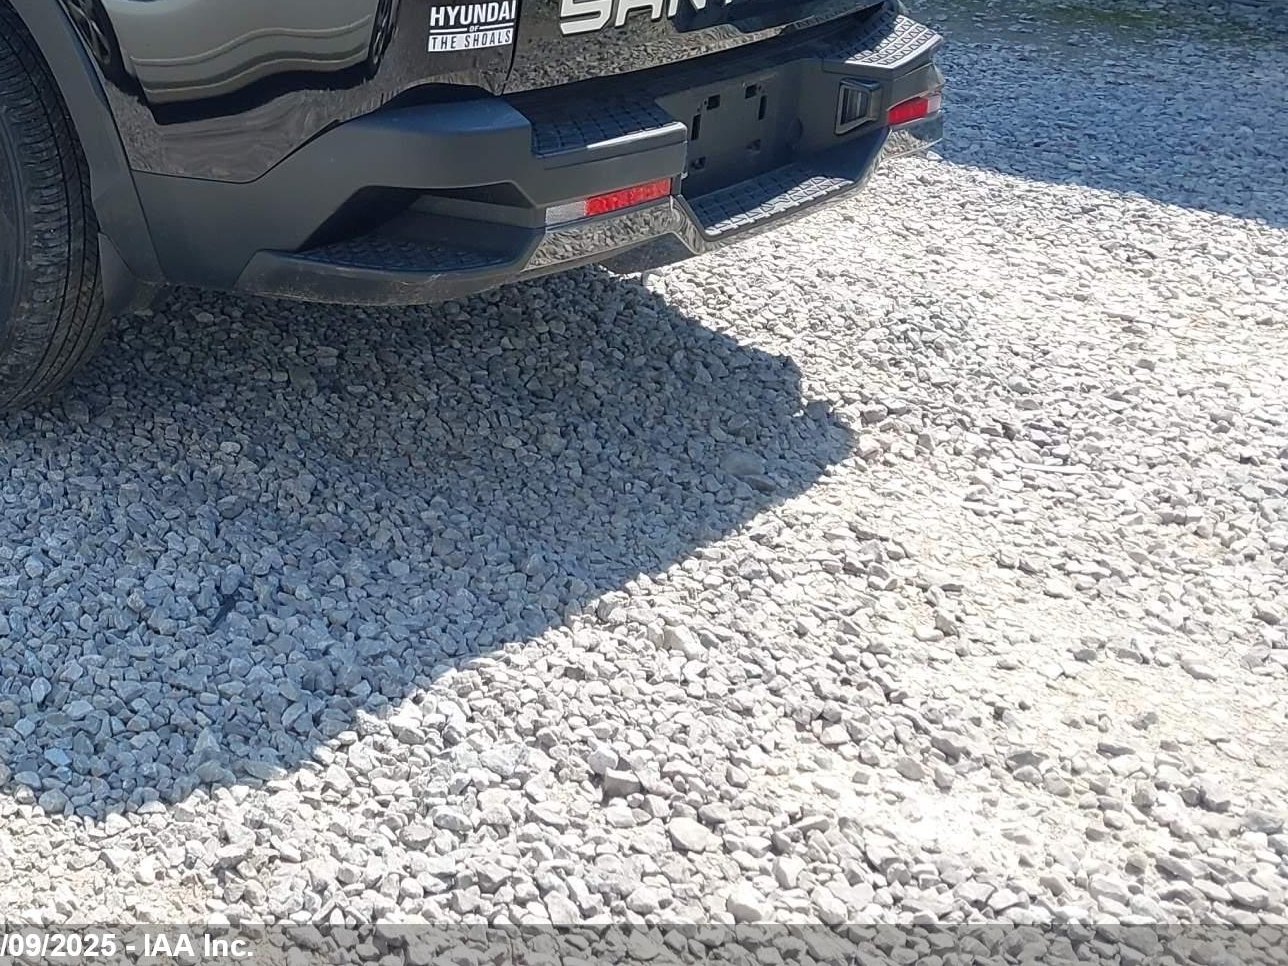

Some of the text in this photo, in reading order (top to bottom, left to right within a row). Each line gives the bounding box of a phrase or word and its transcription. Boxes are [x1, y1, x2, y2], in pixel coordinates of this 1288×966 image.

[429, 0, 517, 27] HYUNDAI
[432, 29, 511, 50] THE SHOALS
